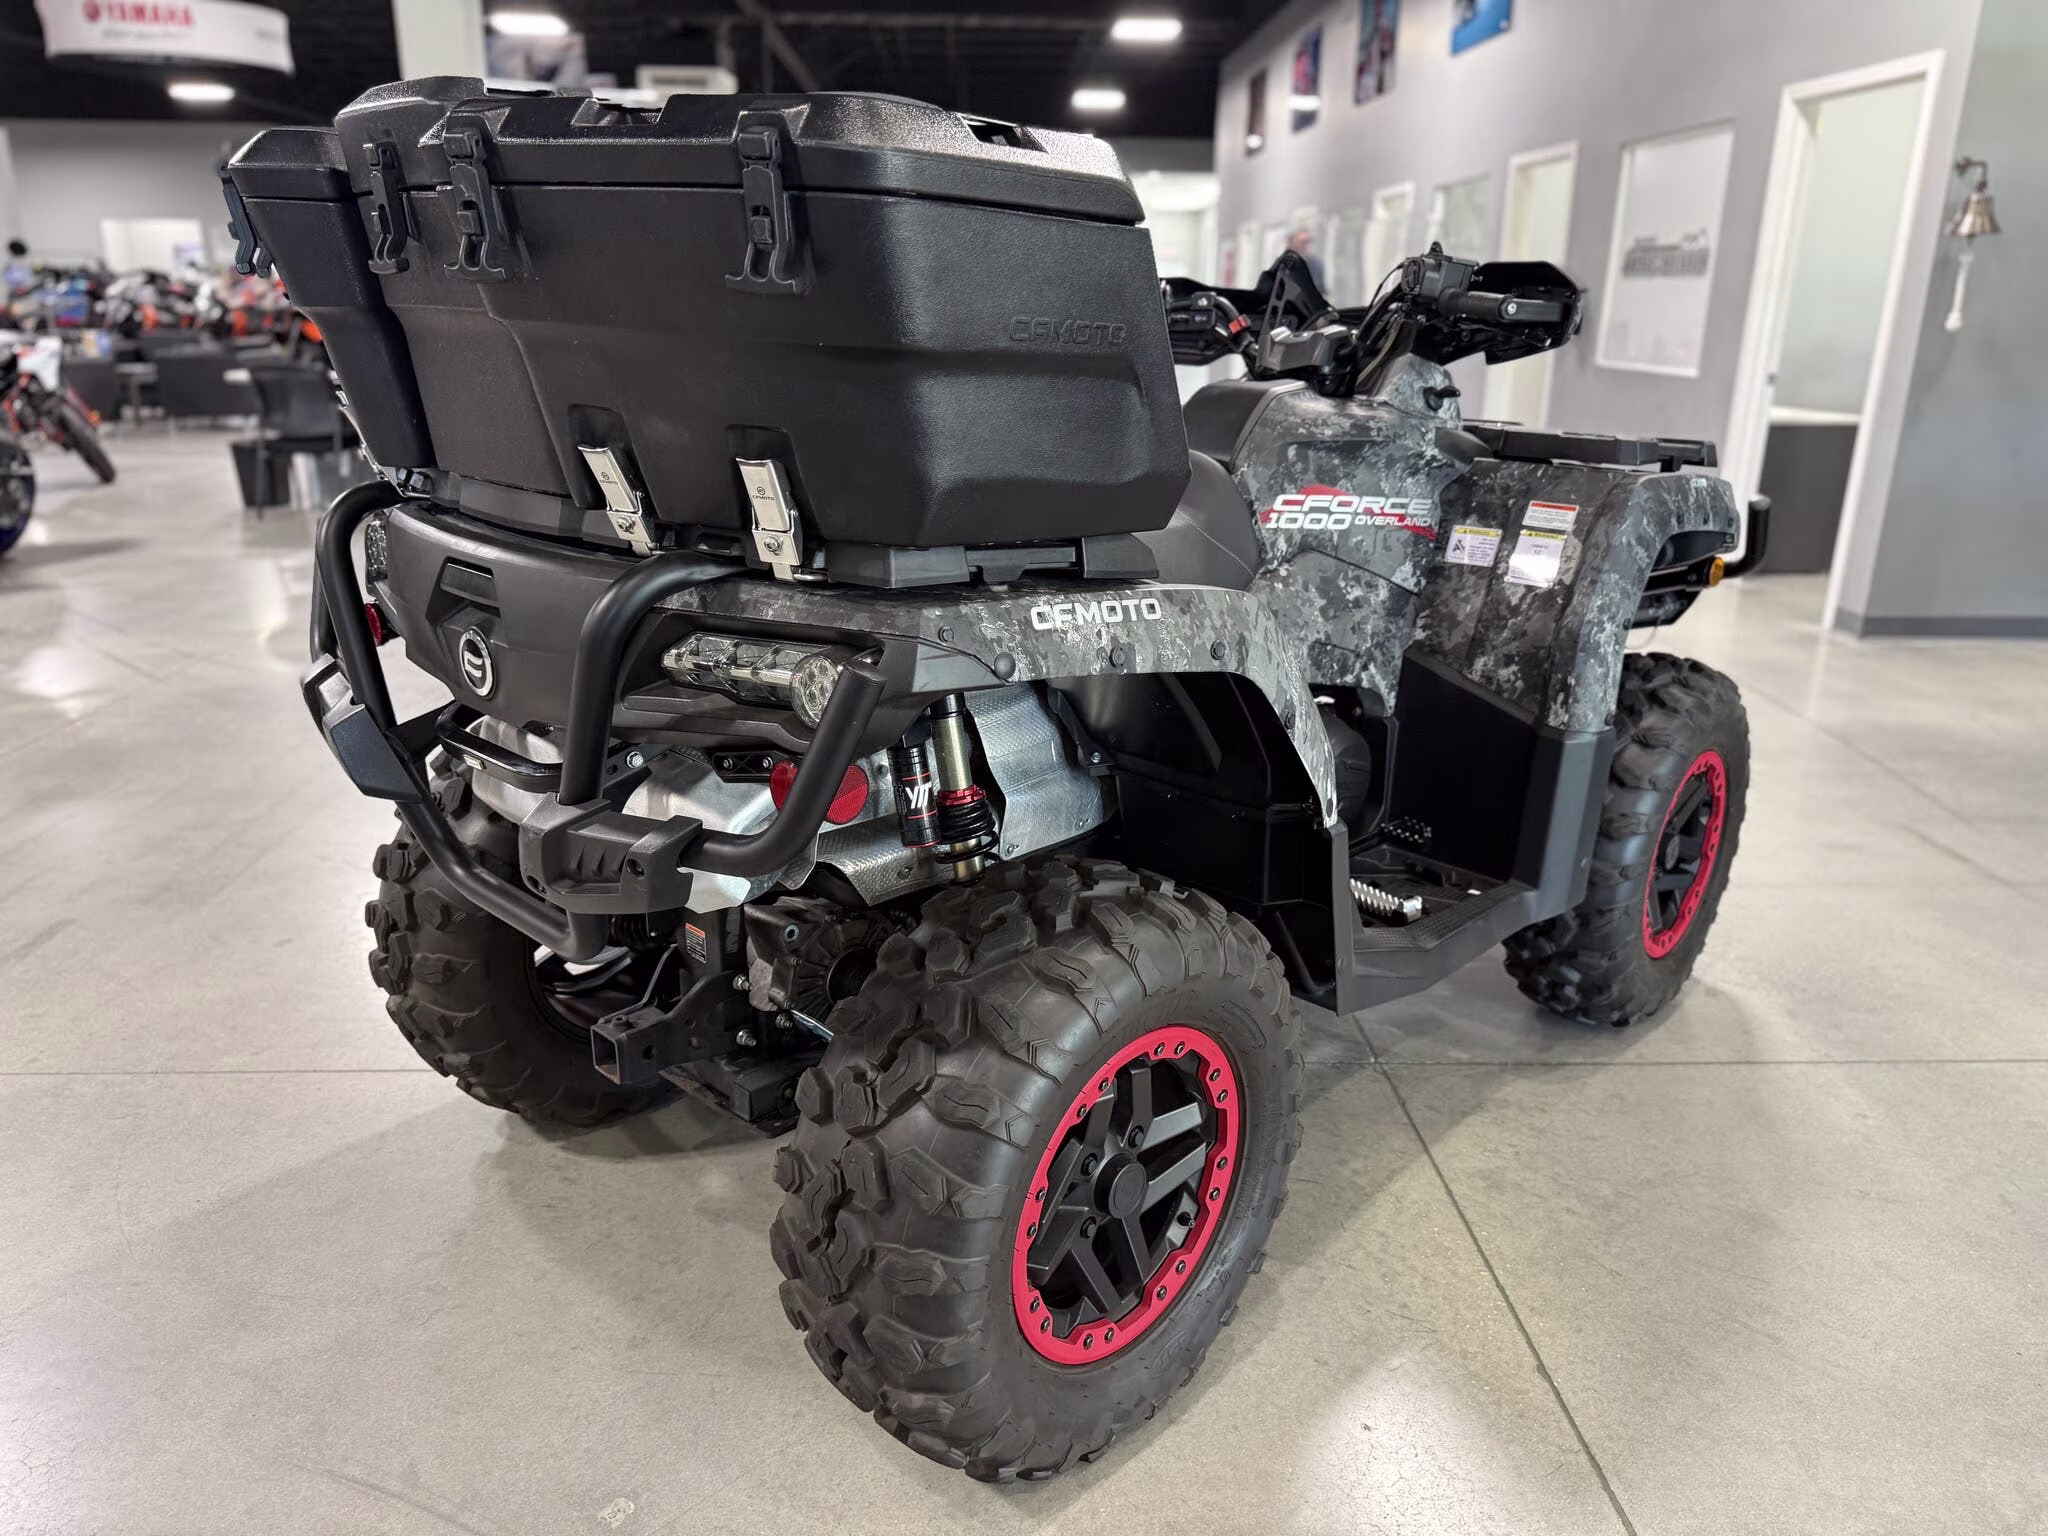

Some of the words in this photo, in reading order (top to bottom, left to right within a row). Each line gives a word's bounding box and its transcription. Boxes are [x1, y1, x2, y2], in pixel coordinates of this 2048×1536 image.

[1010, 317, 1127, 345] CFMOTO
[1272, 494, 1433, 515] CFORCE
[1265, 512, 1352, 530] 1000
[1354, 515, 1432, 527] OVERLAND
[1031, 598, 1162, 631] CFMOTO
